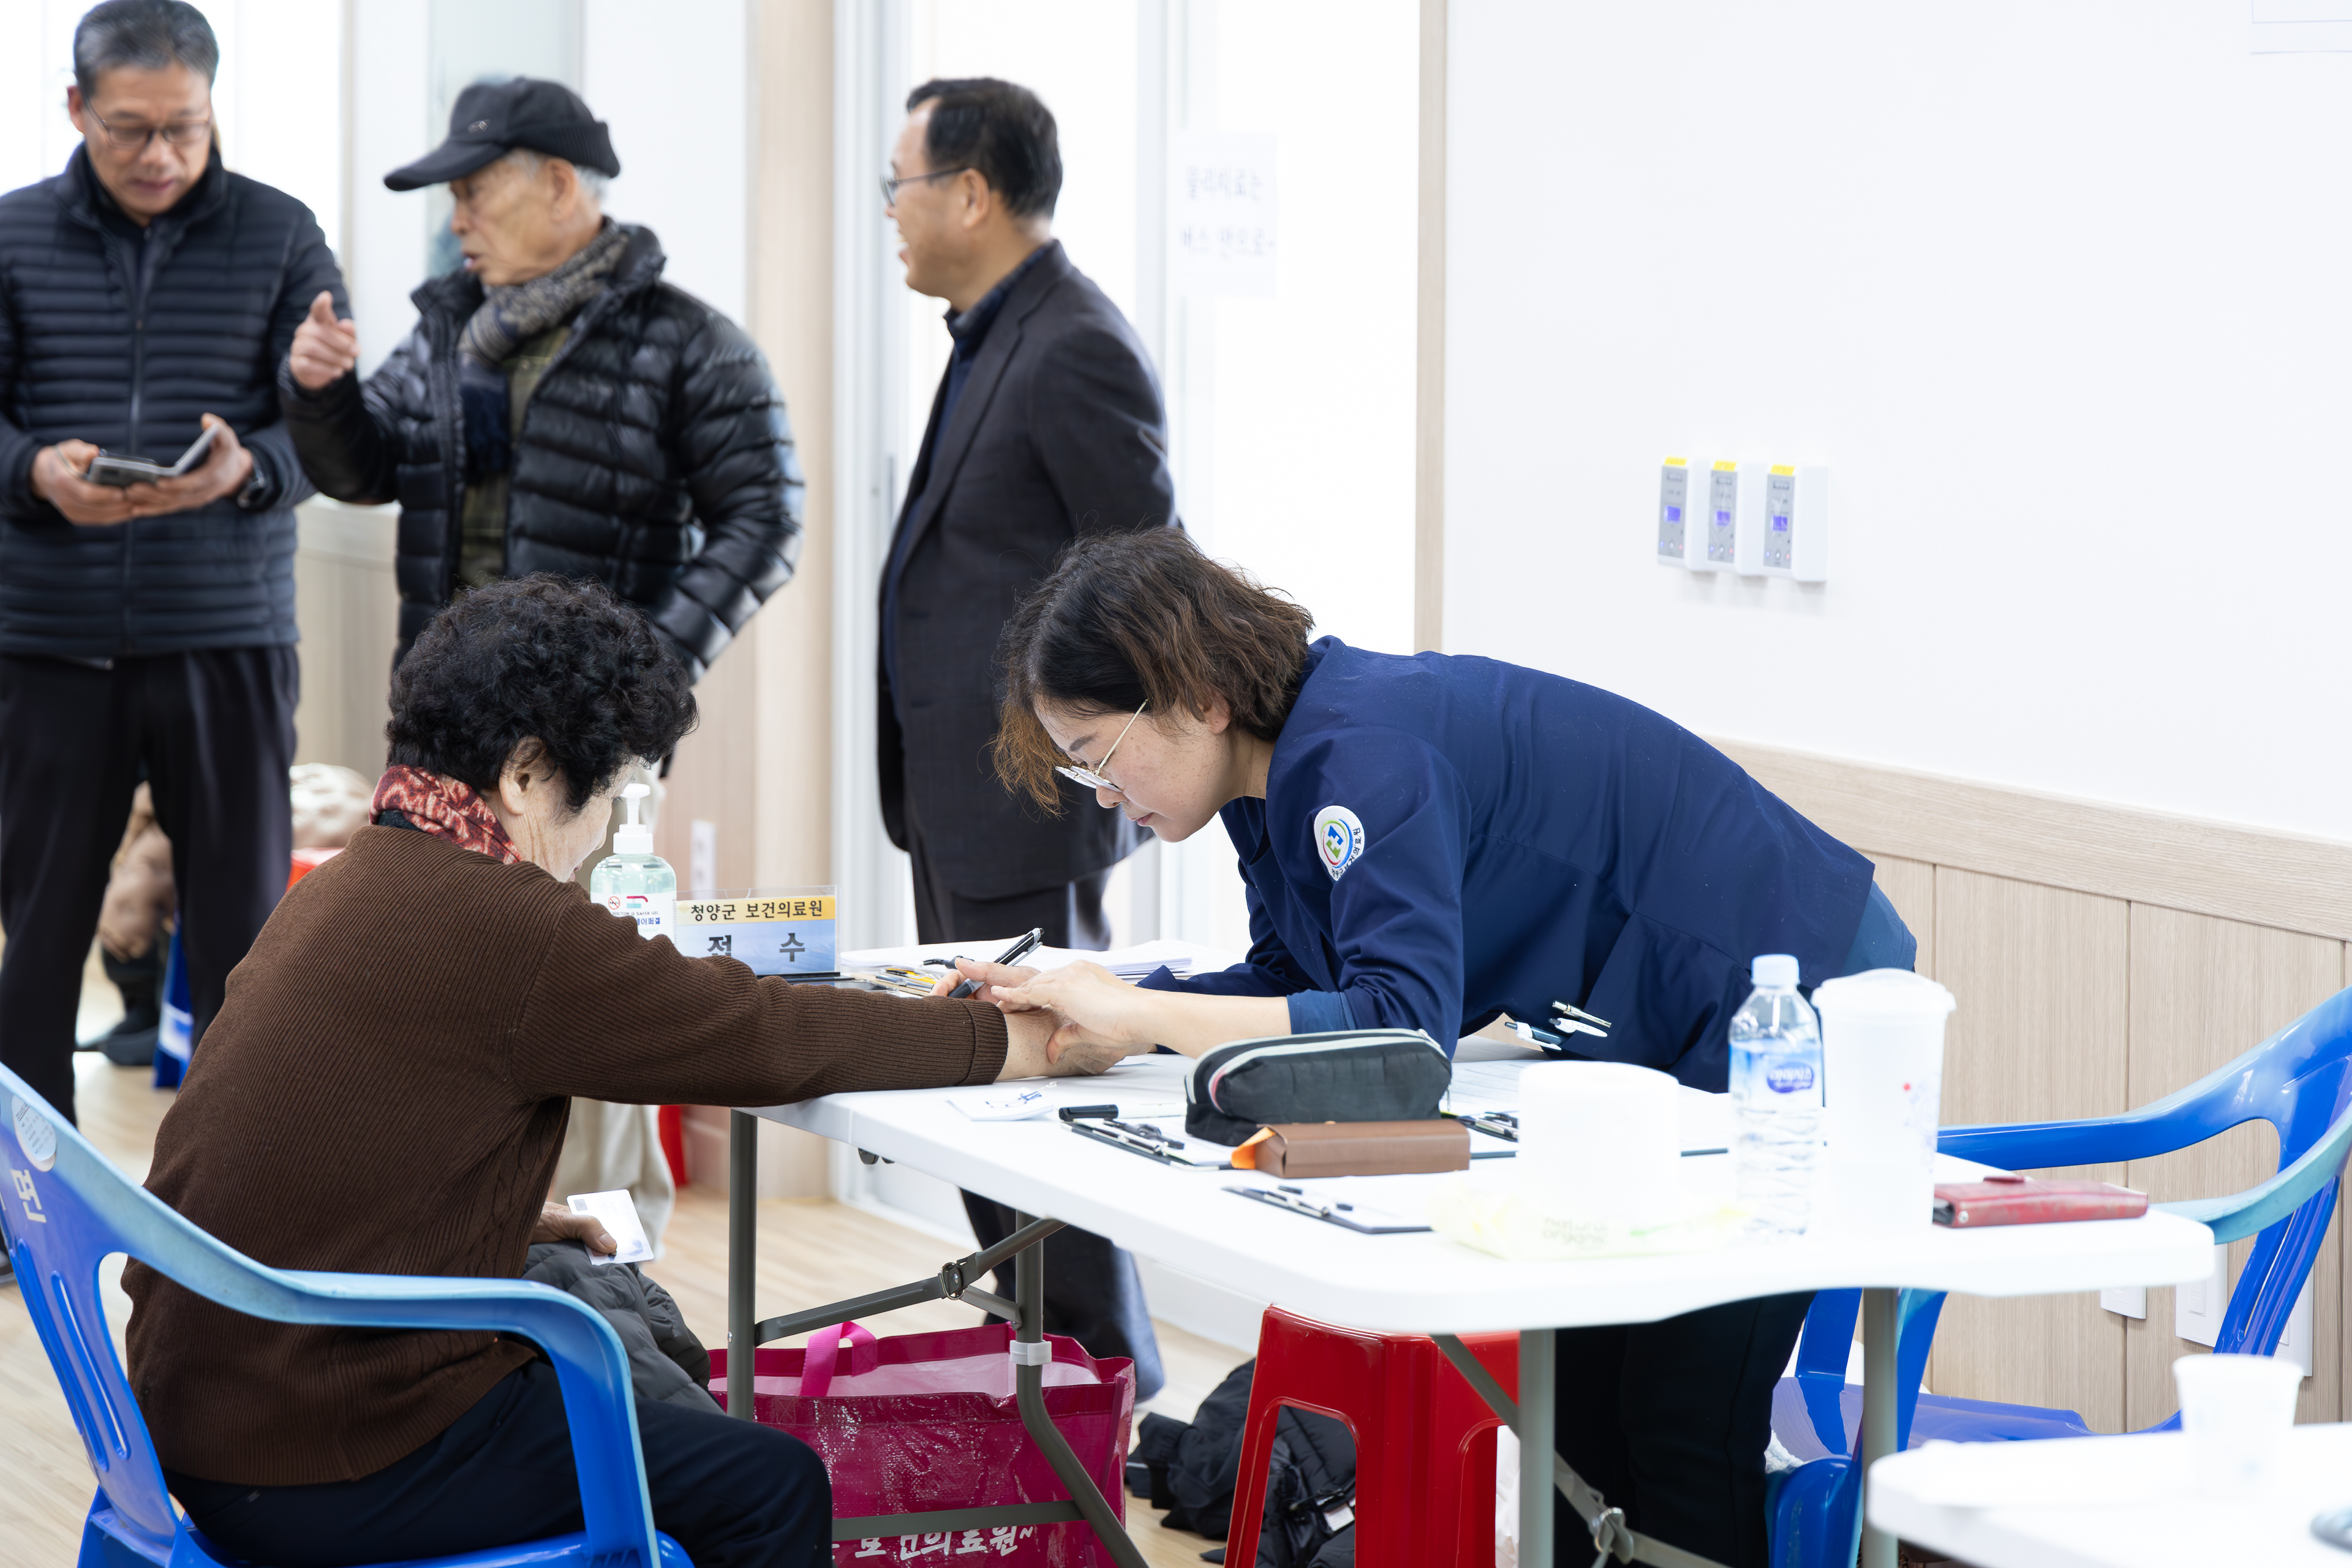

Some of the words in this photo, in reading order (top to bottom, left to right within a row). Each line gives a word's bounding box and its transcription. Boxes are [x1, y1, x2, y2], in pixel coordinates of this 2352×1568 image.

[691, 904, 736, 922] 청양군
[745, 900, 822, 919] 보건의료원
[636, 917, 660, 925] 이퍼겔
